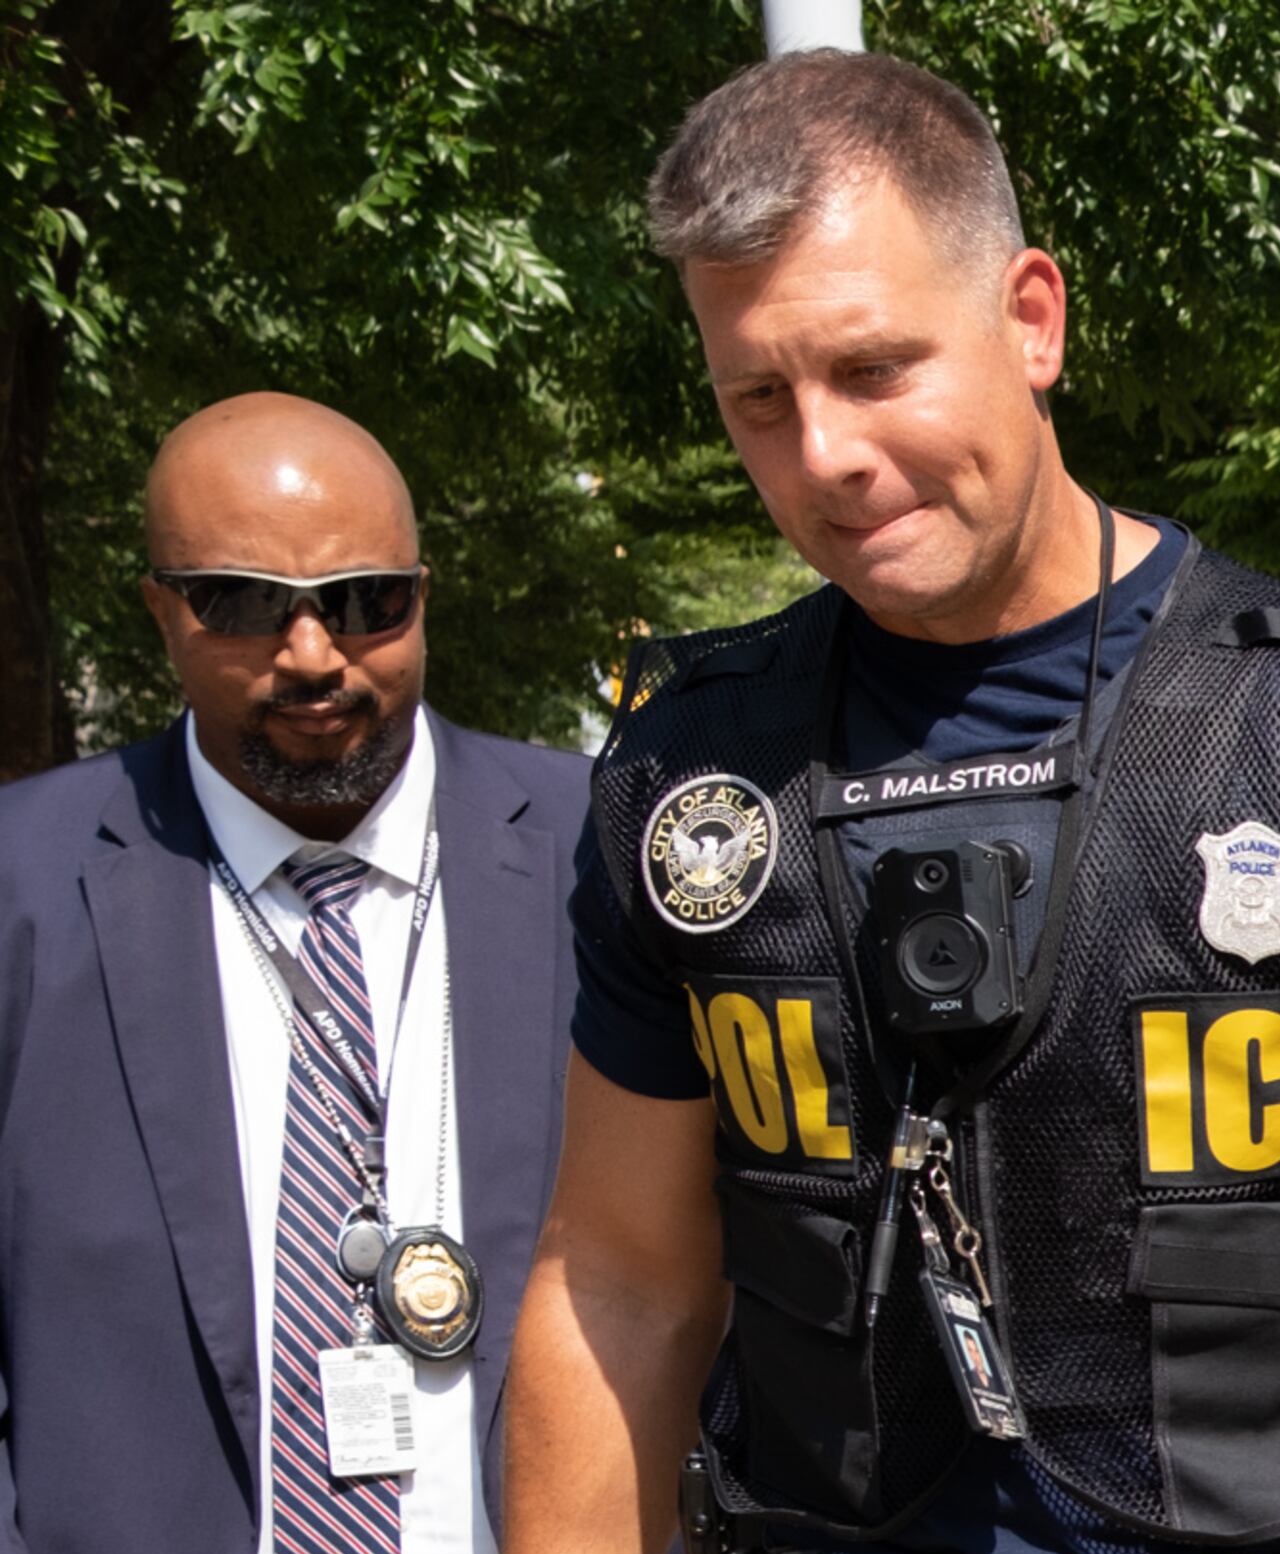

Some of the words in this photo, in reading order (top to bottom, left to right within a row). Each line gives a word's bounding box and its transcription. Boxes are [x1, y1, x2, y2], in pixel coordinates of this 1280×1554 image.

[843, 781, 870, 804] C.
[881, 757, 1056, 800] MALSTROM
[651, 809, 678, 862] CITY
[678, 786, 709, 813] OF
[712, 785, 768, 861] ATLANTA
[1228, 861, 1277, 877] POLICE
[663, 887, 747, 920] POLICE
[929, 999, 963, 1012] AXON
[312, 1010, 343, 1040] APD
